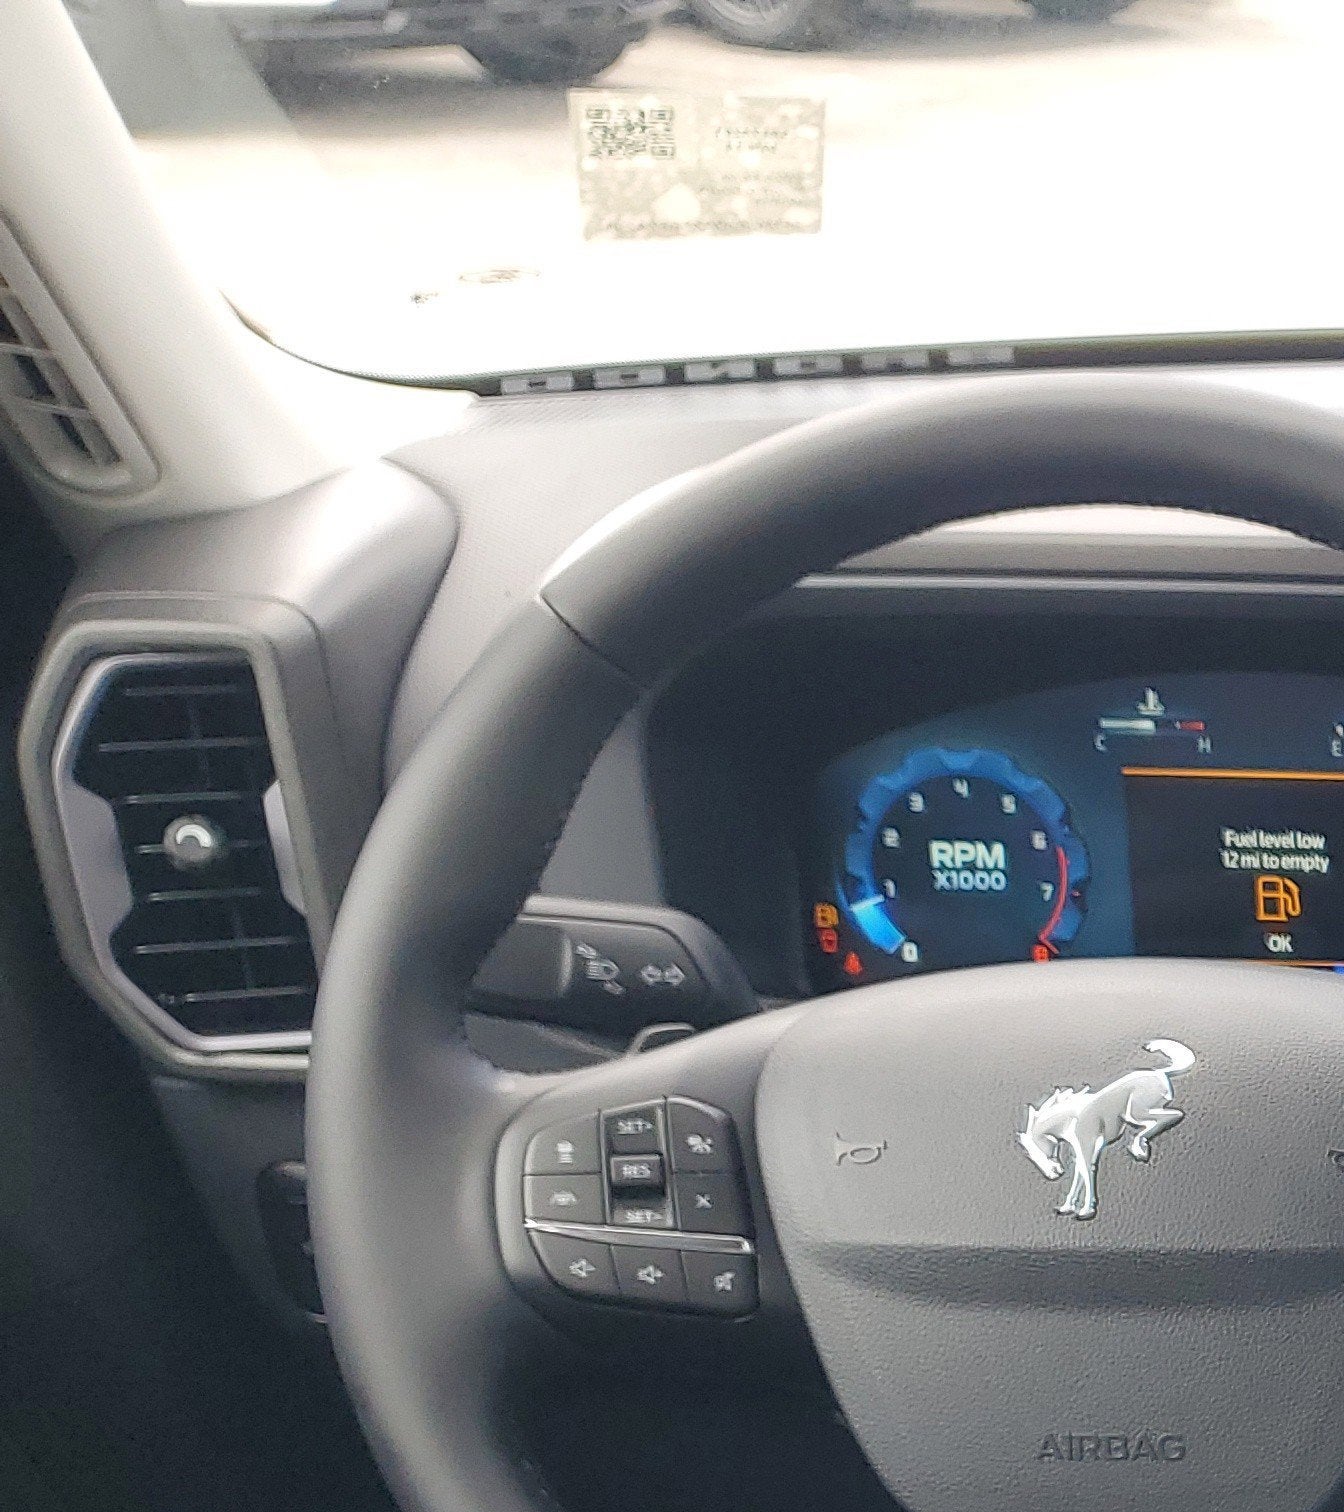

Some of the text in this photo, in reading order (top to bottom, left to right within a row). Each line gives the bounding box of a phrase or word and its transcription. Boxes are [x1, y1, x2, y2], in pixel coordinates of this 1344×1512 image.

[953, 778, 970, 798] 4
[1222, 828, 1326, 850] Fuel level low
[929, 839, 1006, 869] RPM
[1220, 849, 1240, 869] 12
[1261, 852, 1280, 870] to
[1281, 853, 1330, 873] empty
[1040, 882, 1055, 901] 7
[901, 942, 918, 962] 0
[1264, 932, 1293, 952] OK
[1036, 1432, 1187, 1462] AIRBAG
